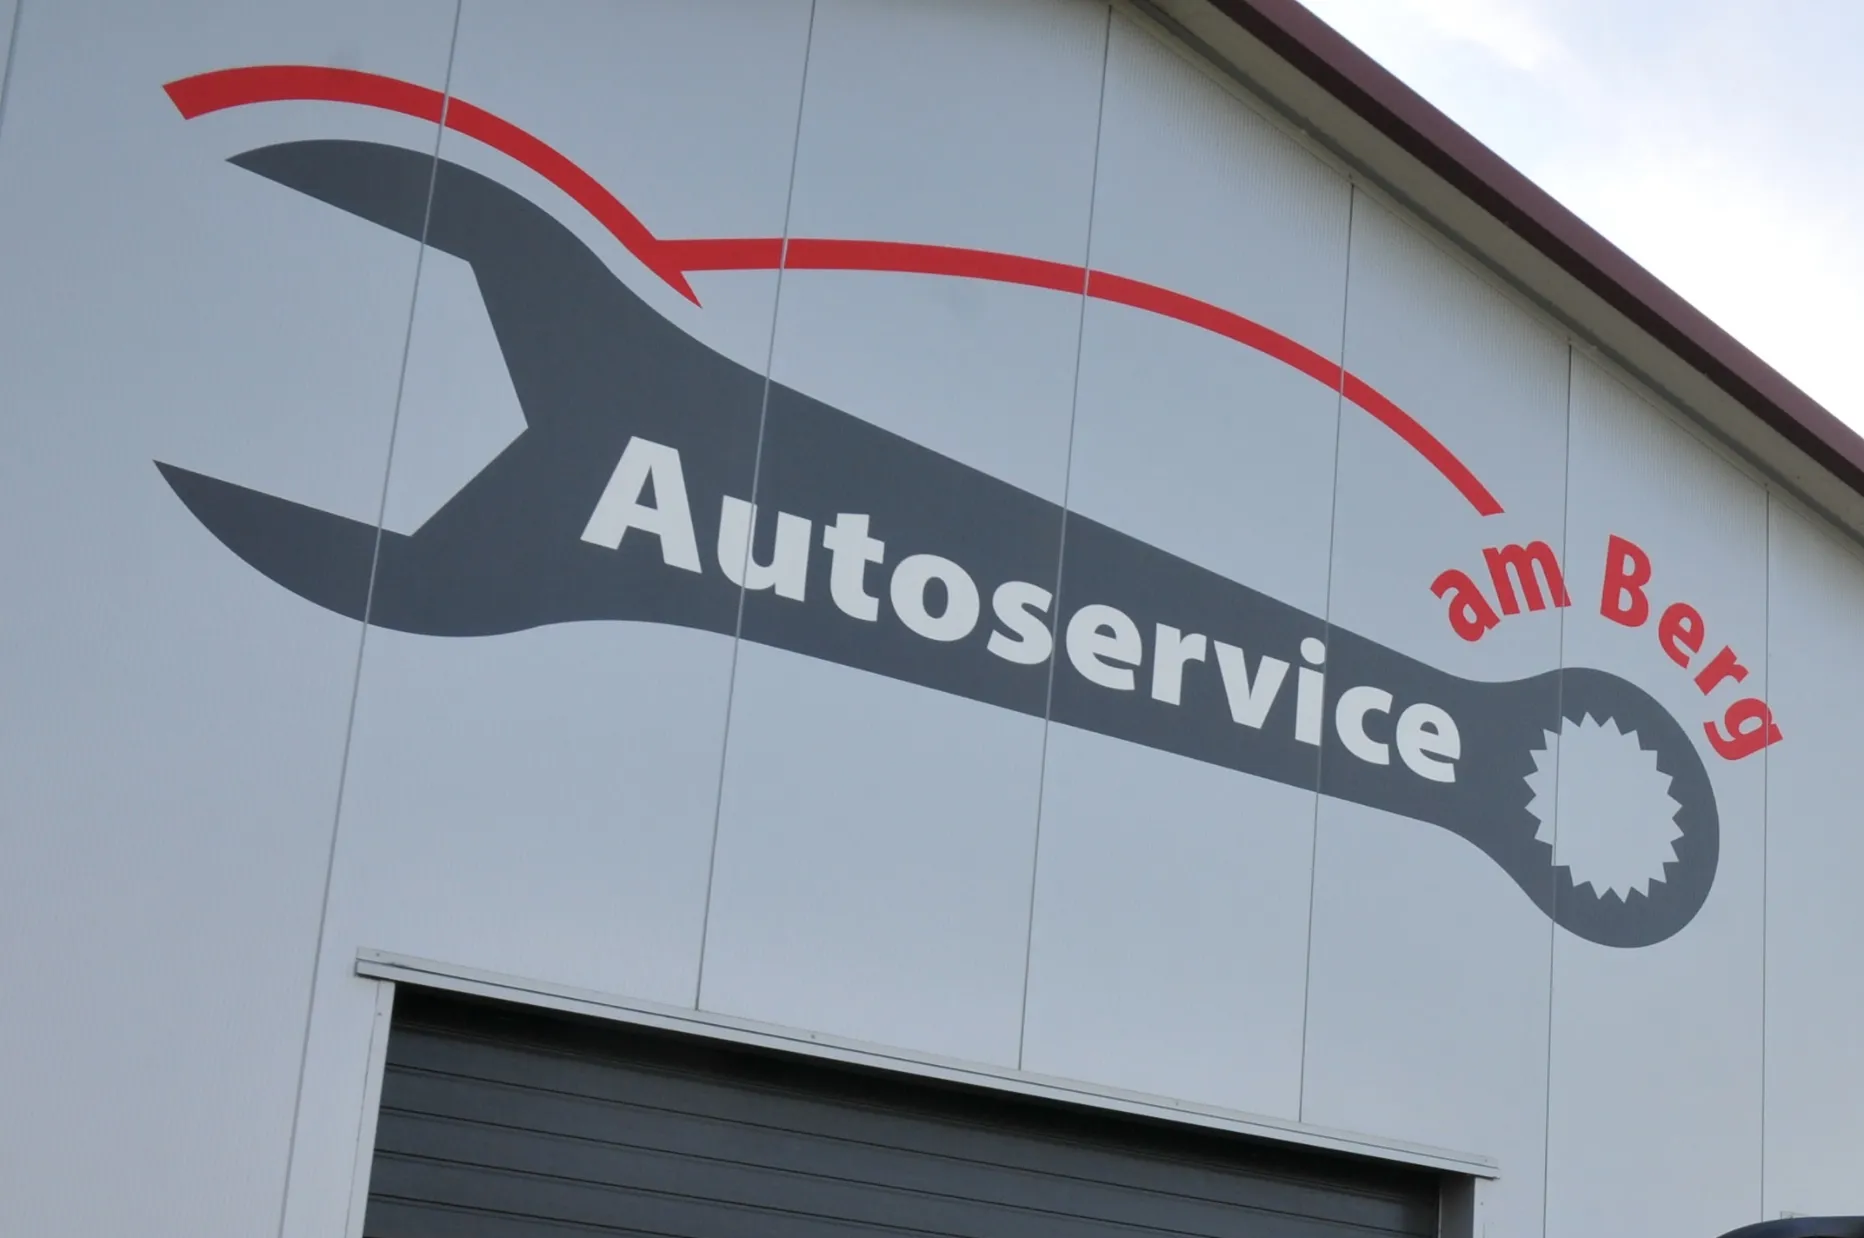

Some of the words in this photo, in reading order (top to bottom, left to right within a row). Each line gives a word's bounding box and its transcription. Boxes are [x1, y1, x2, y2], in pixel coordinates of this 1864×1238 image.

[580, 436, 1461, 782] Autoservice
[1430, 540, 1572, 642] am
[1600, 534, 1783, 761] Berg
